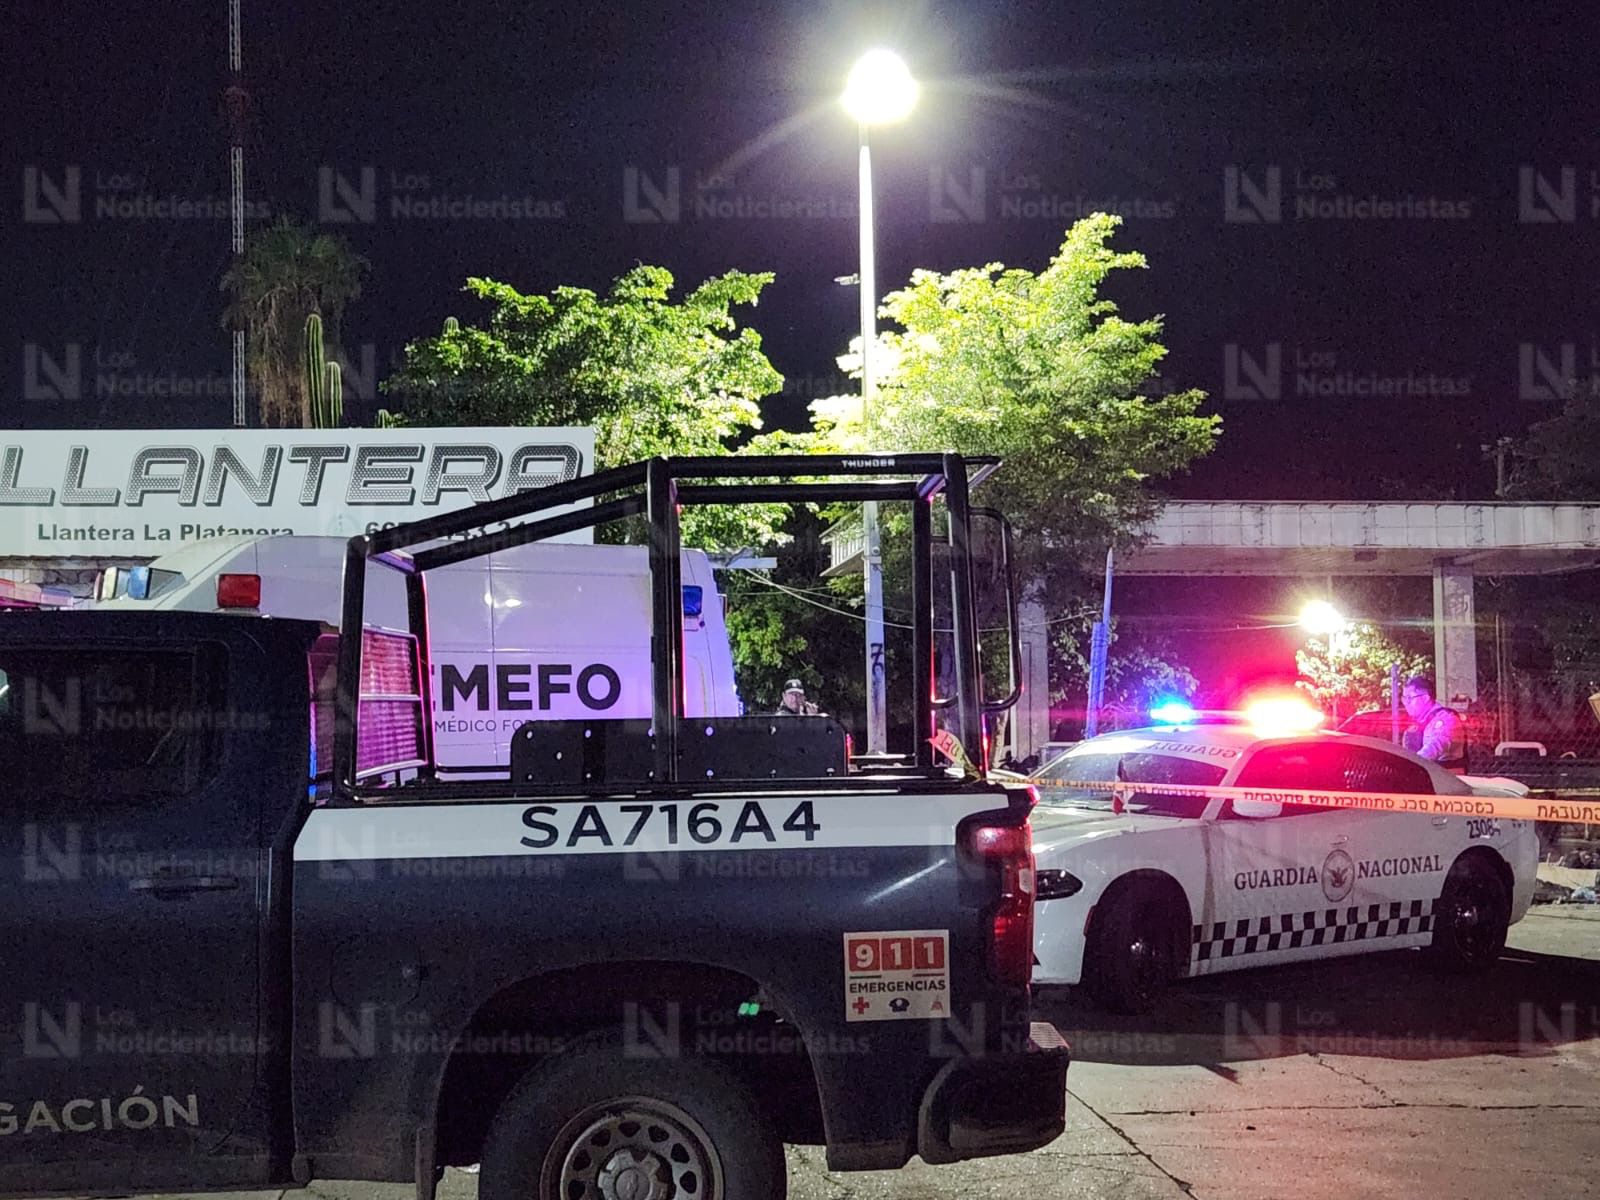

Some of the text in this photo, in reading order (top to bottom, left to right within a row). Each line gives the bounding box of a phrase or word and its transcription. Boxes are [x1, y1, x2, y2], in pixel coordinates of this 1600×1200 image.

[0, 443, 584, 507] LLANTERA
[841, 459, 896, 469] THUNDER
[38, 524, 134, 541] Llantera
[144, 524, 171, 541] La
[431, 663, 622, 711] MEFO
[434, 716, 497, 732] MÉDICO
[520, 801, 821, 848] SA716A4
[1234, 854, 1443, 891] GUARDIA NACIONAL
[855, 942, 935, 968] 911
[849, 980, 946, 994] EMERGENCIAS
